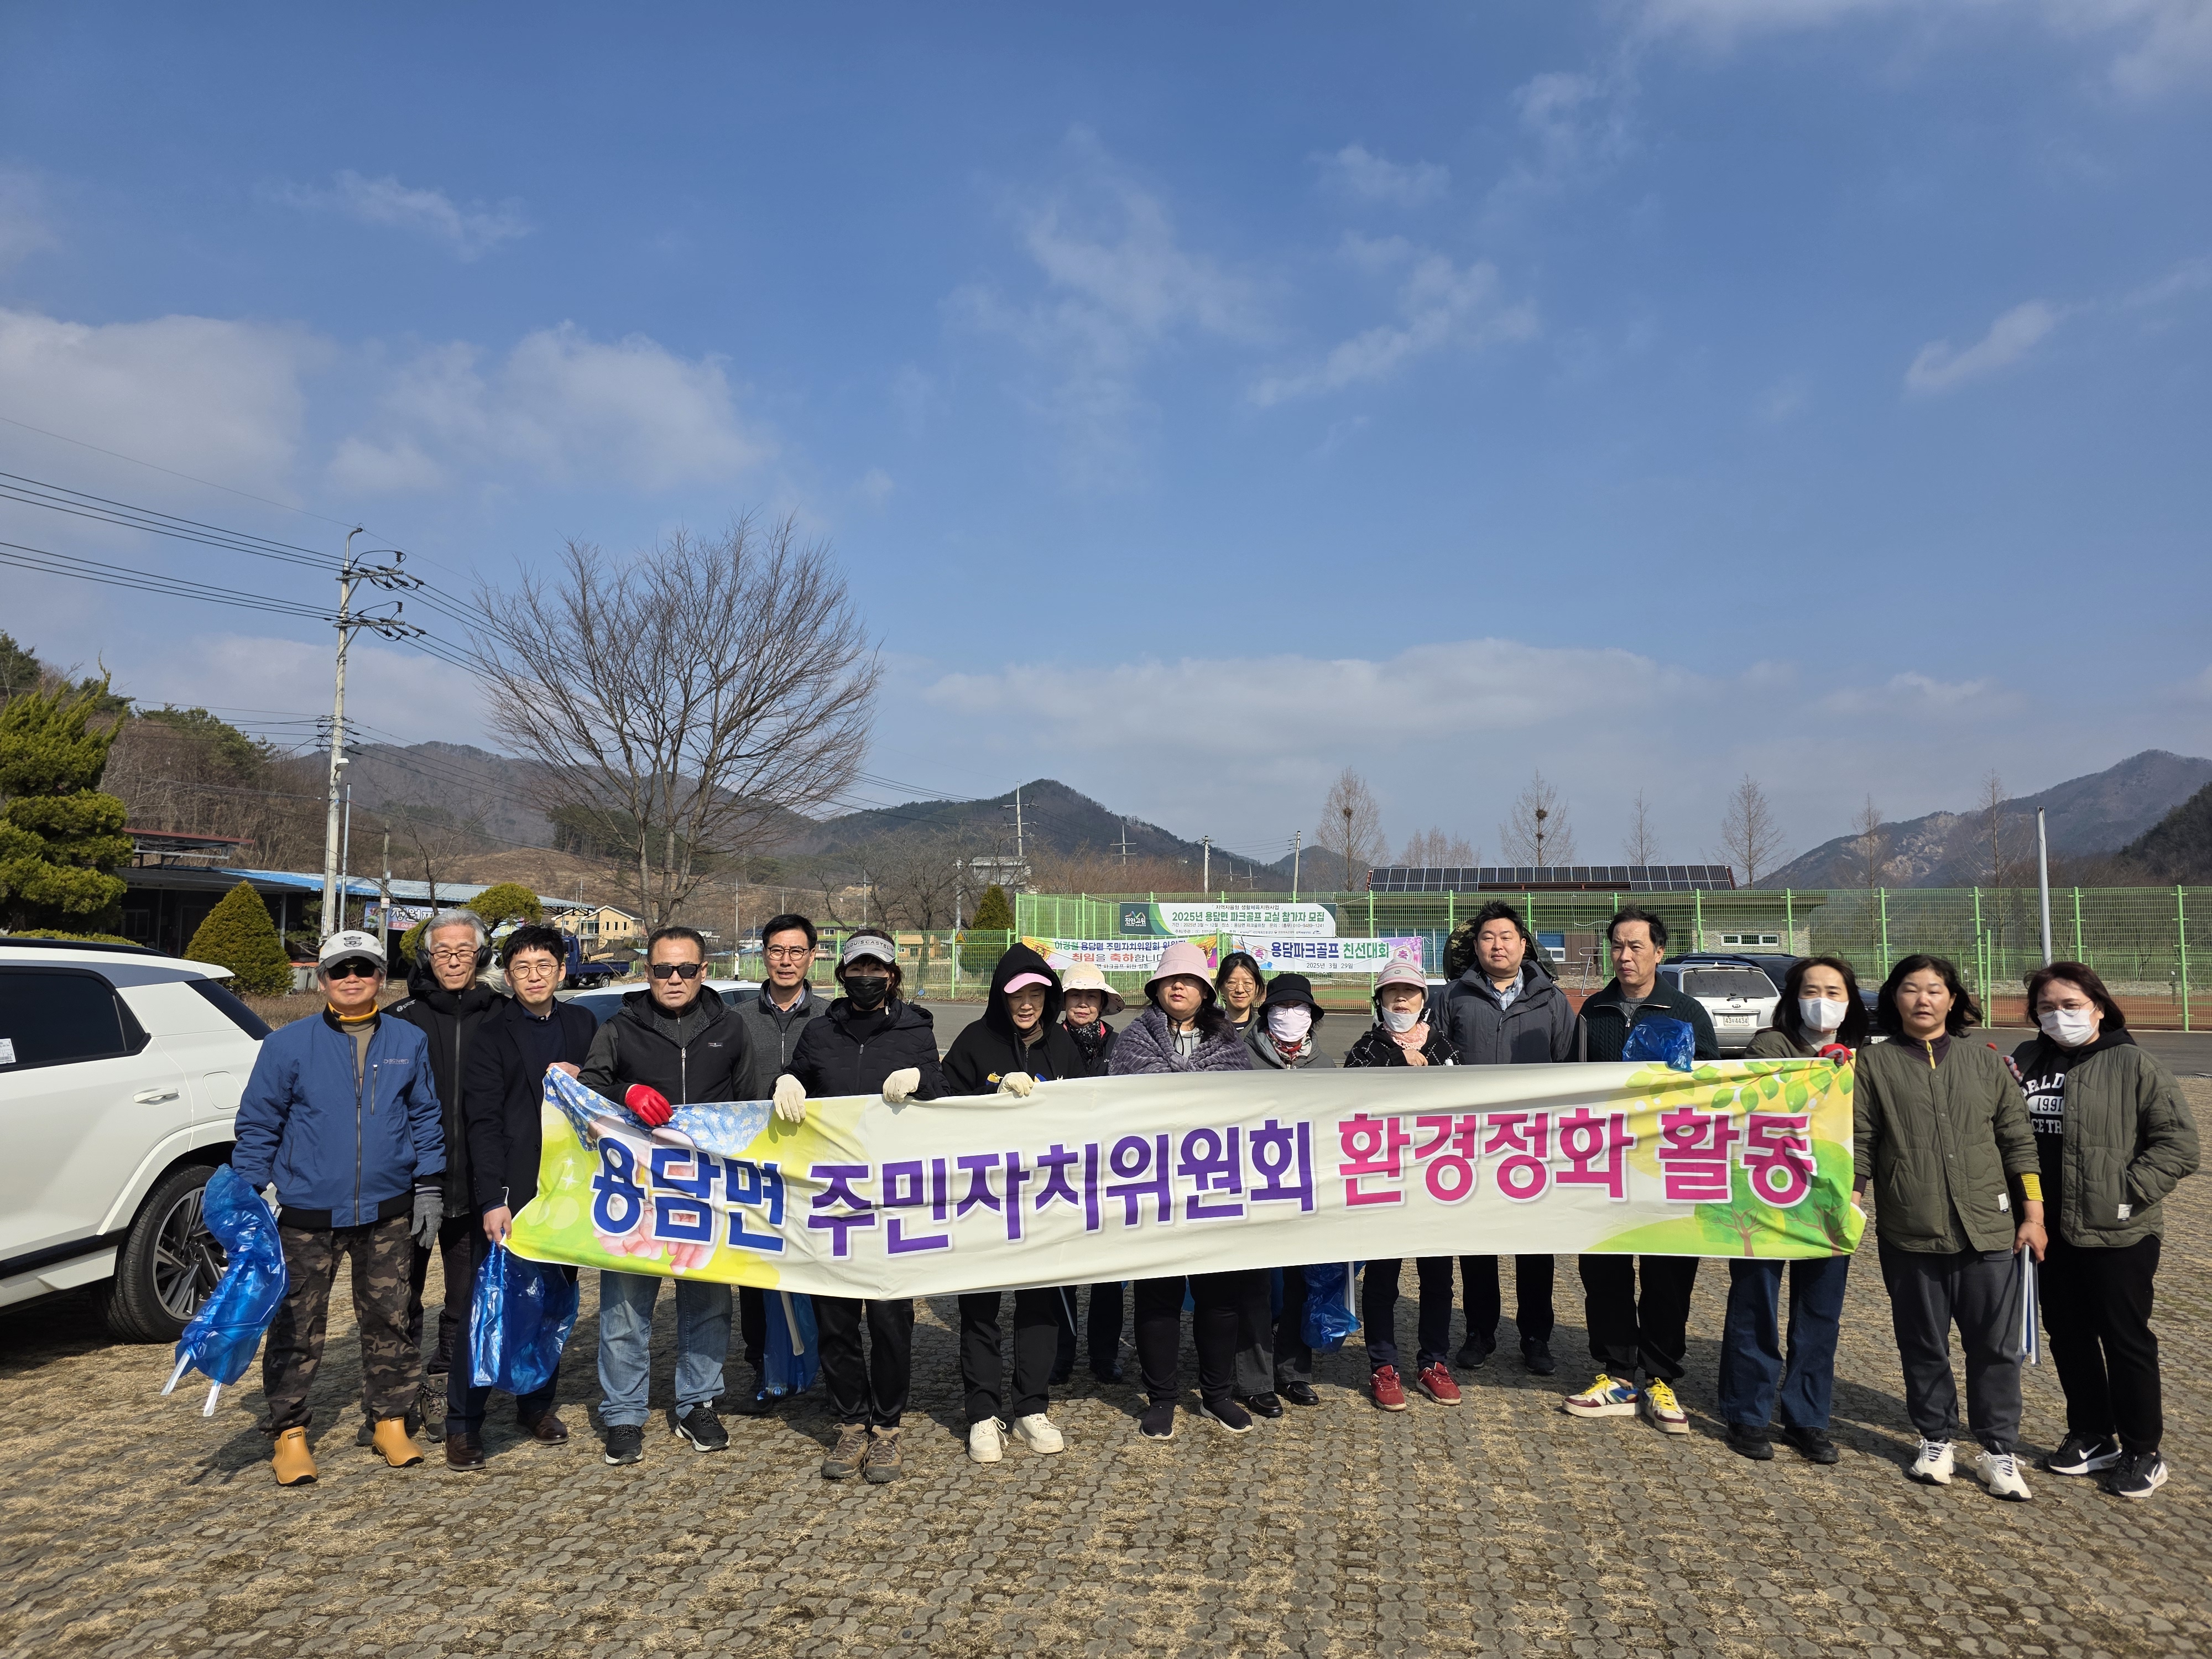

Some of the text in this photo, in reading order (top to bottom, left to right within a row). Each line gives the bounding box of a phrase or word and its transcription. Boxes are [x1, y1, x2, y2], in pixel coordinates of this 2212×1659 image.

[1172, 911, 1324, 922] 2025년 용담면 파크골프 교실 참가자 모집
[1055, 941, 1078, 951] 이경철
[1081, 942, 1103, 951] 용담면
[1107, 942, 1160, 951] 주민자치위원회
[1271, 942, 1390, 959] 용담파크골프 친선대회
[1072, 953, 1105, 962] 취임을
[1255, 948, 1264, 959] 축
[591, 1107, 1814, 1257] 용담면 주민자치위원회 환경정화 활동
